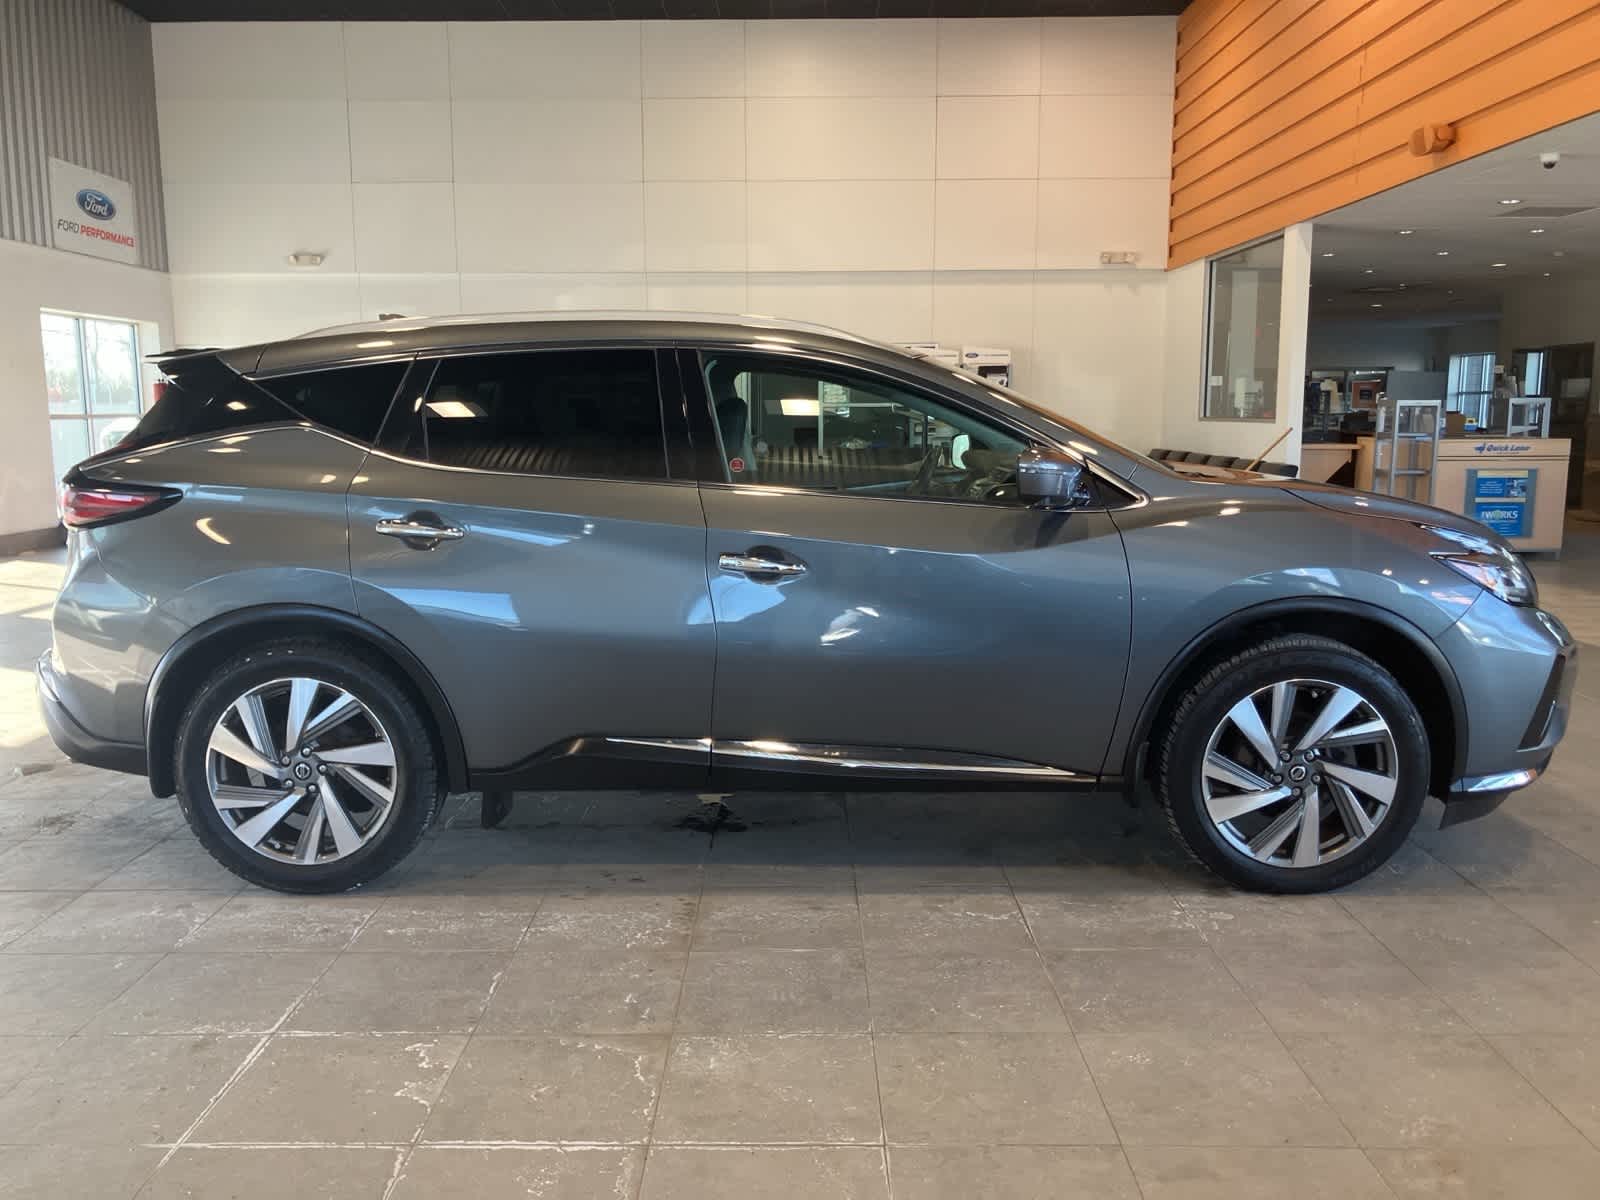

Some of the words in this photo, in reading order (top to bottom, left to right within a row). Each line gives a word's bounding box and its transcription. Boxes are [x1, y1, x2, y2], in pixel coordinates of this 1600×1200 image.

[84, 192, 109, 216] Ford
[57, 219, 79, 233] FORD
[80, 225, 134, 247] PERFORMANCE
